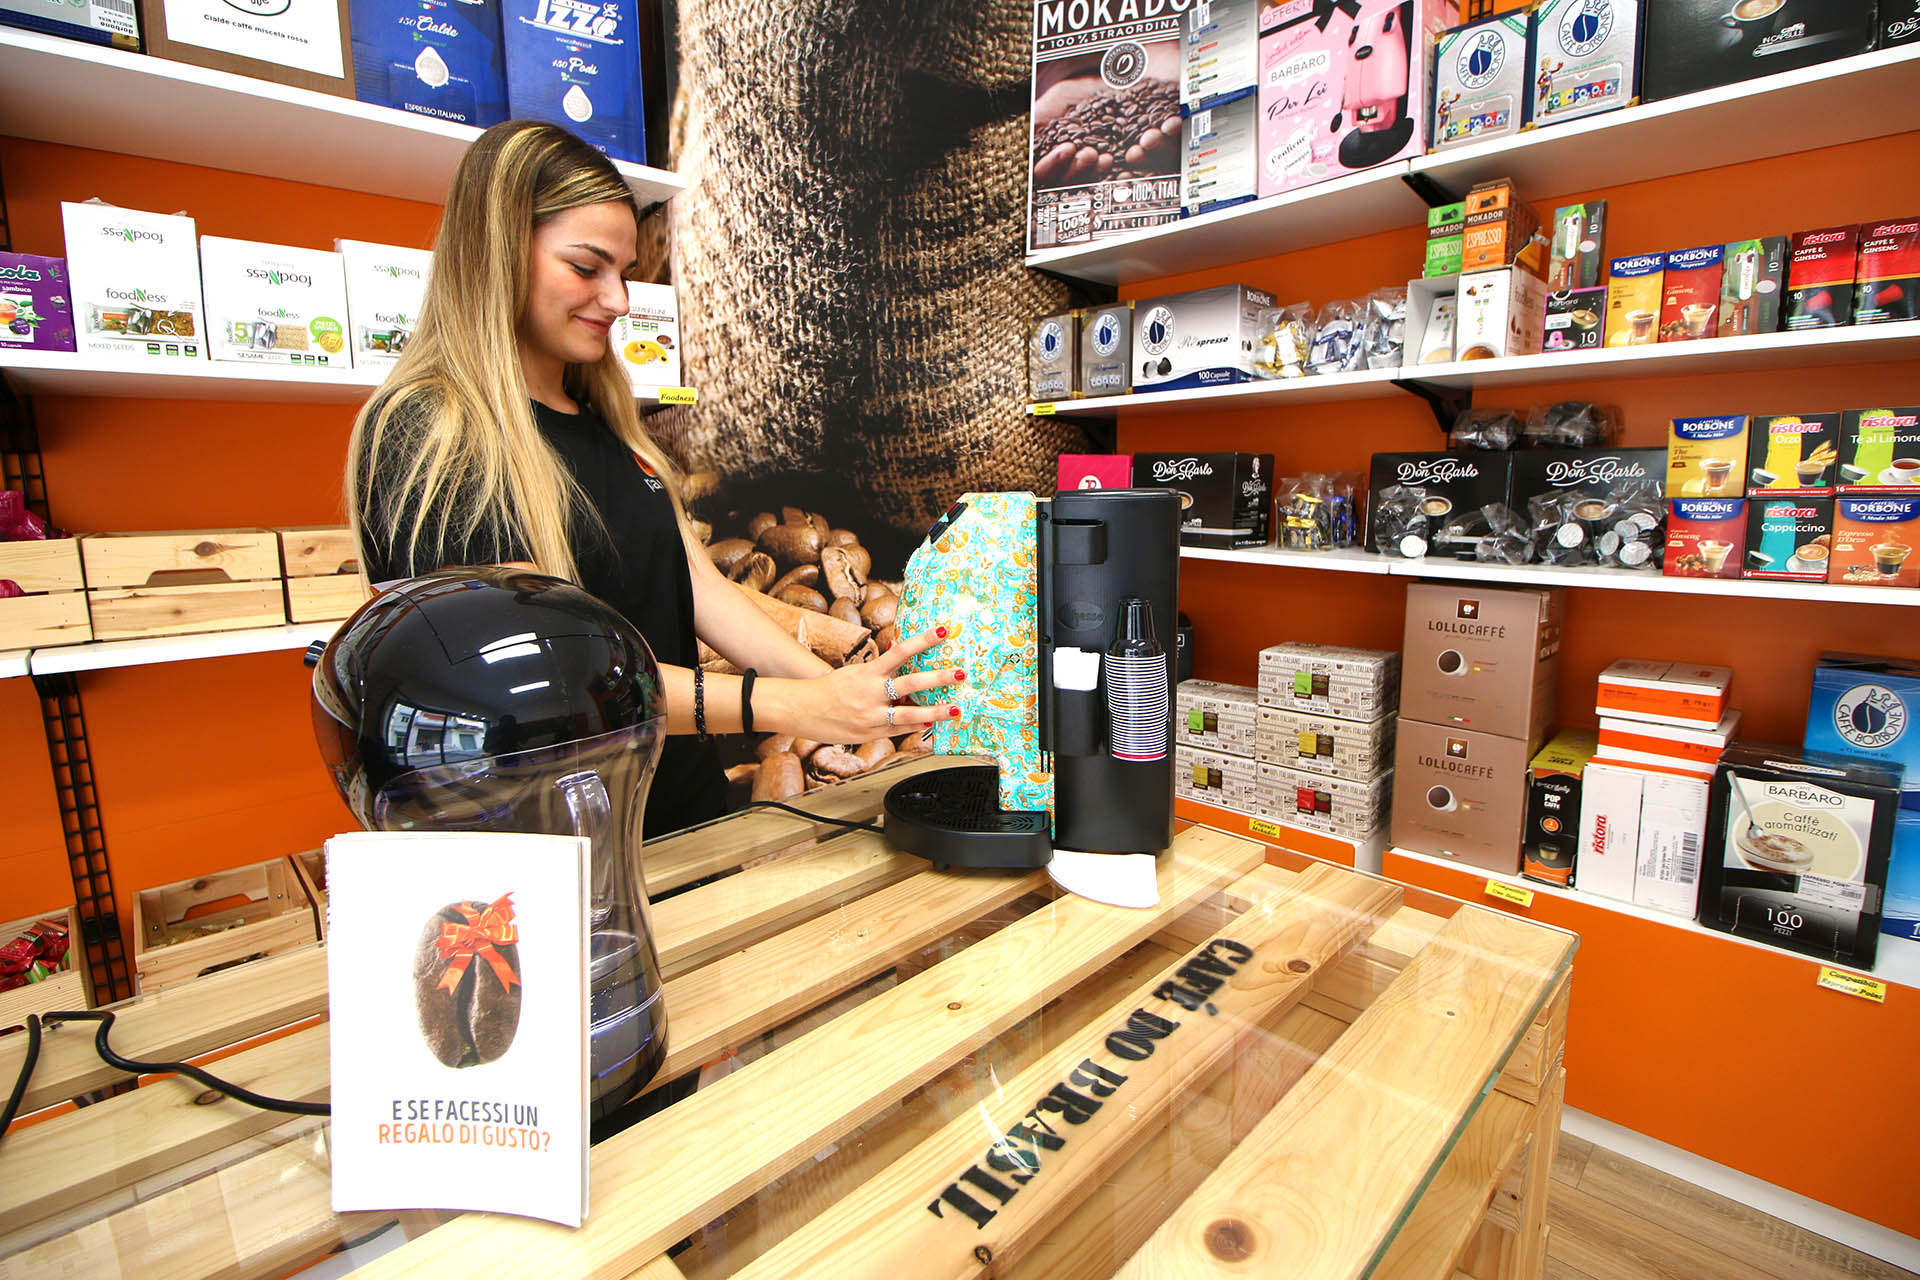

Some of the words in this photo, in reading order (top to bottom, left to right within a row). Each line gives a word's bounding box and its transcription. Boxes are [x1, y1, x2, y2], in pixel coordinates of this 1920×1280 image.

[203, 14, 230, 25] Cialde
[254, 26, 286, 38] miscela
[287, 34, 308, 44] rossa
[399, 16, 416, 26] 150
[416, 15, 459, 37] Cialde
[1050, 32, 1088, 49] 100%
[568, 56, 598, 75] Pods
[1270, 54, 1326, 83] BARBARO
[1268, 96, 1299, 120] Per
[1303, 81, 1328, 106] Lei
[404, 102, 436, 116] ESPRESSO
[436, 107, 466, 122] ITALIANO
[1057, 213, 1090, 233] 100%
[1467, 210, 1504, 224] MOKADOR
[1058, 227, 1090, 242] SAPERE
[1430, 223, 1464, 236] MOKADOR
[1872, 223, 1919, 237] ristora
[1466, 227, 1502, 249] ESPRESSO
[1803, 232, 1846, 246] ristora
[1669, 248, 1719, 263] BORBONE
[1863, 244, 1899, 255] GINSENG
[1614, 256, 1661, 271] BORBONE
[1794, 252, 1828, 263] GINSENG
[1769, 261, 1779, 272] 10
[1794, 292, 1803, 300] 10
[1863, 285, 1872, 293] 10
[1580, 331, 1597, 344] 10
[88, 341, 112, 351] MIXED
[112, 342, 136, 352] SEEDS
[237, 352, 265, 360] SESAME
[1198, 371, 1210, 380] 100
[1210, 370, 1231, 379] Capsule
[661, 392, 695, 402] Foodness
[1682, 420, 1735, 432] BORBONE
[1770, 422, 1821, 435] ristora
[1860, 415, 1916, 428] ristora
[1775, 434, 1802, 445] Orzo
[1866, 433, 1877, 444] al
[1879, 433, 1920, 443] Limone
[1153, 459, 1178, 478] Don
[1178, 458, 1213, 480] Carlo
[1397, 459, 1431, 482] Don
[1432, 459, 1479, 483] Carlo
[1546, 460, 1587, 482] Don
[1588, 458, 1646, 484] Carlo
[1681, 503, 1733, 513] BORBONE
[1766, 505, 1817, 519] ristora
[1850, 503, 1912, 513] BORBONE
[1761, 522, 1826, 533] Cappuccino
[1838, 529, 1874, 538] Espresso
[1669, 532, 1701, 541] Ginseng
[1854, 712, 1903, 745] BORBONE
[1544, 793, 1561, 803] POP
[1768, 785, 1843, 806] BARBARO
[1783, 812, 1820, 826] Caffè
[1594, 814, 1607, 856] ristora
[1764, 820, 1838, 841] aromatizzati
[1767, 906, 1803, 930] 100
[1773, 926, 1792, 937] PEZZI
[1828, 970, 1878, 989] Compatibili
[1859, 988, 1882, 1000] Point
[392, 1099, 403, 1121] E
[407, 1099, 429, 1121] SE
[435, 1099, 510, 1124] FACESSI
[514, 1104, 538, 1128] UN
[378, 1122, 454, 1145] REGALO
[459, 1124, 478, 1146] DI
[482, 1125, 551, 1153] GUSTO?
[927, 1057, 1129, 1231] BRASIL
